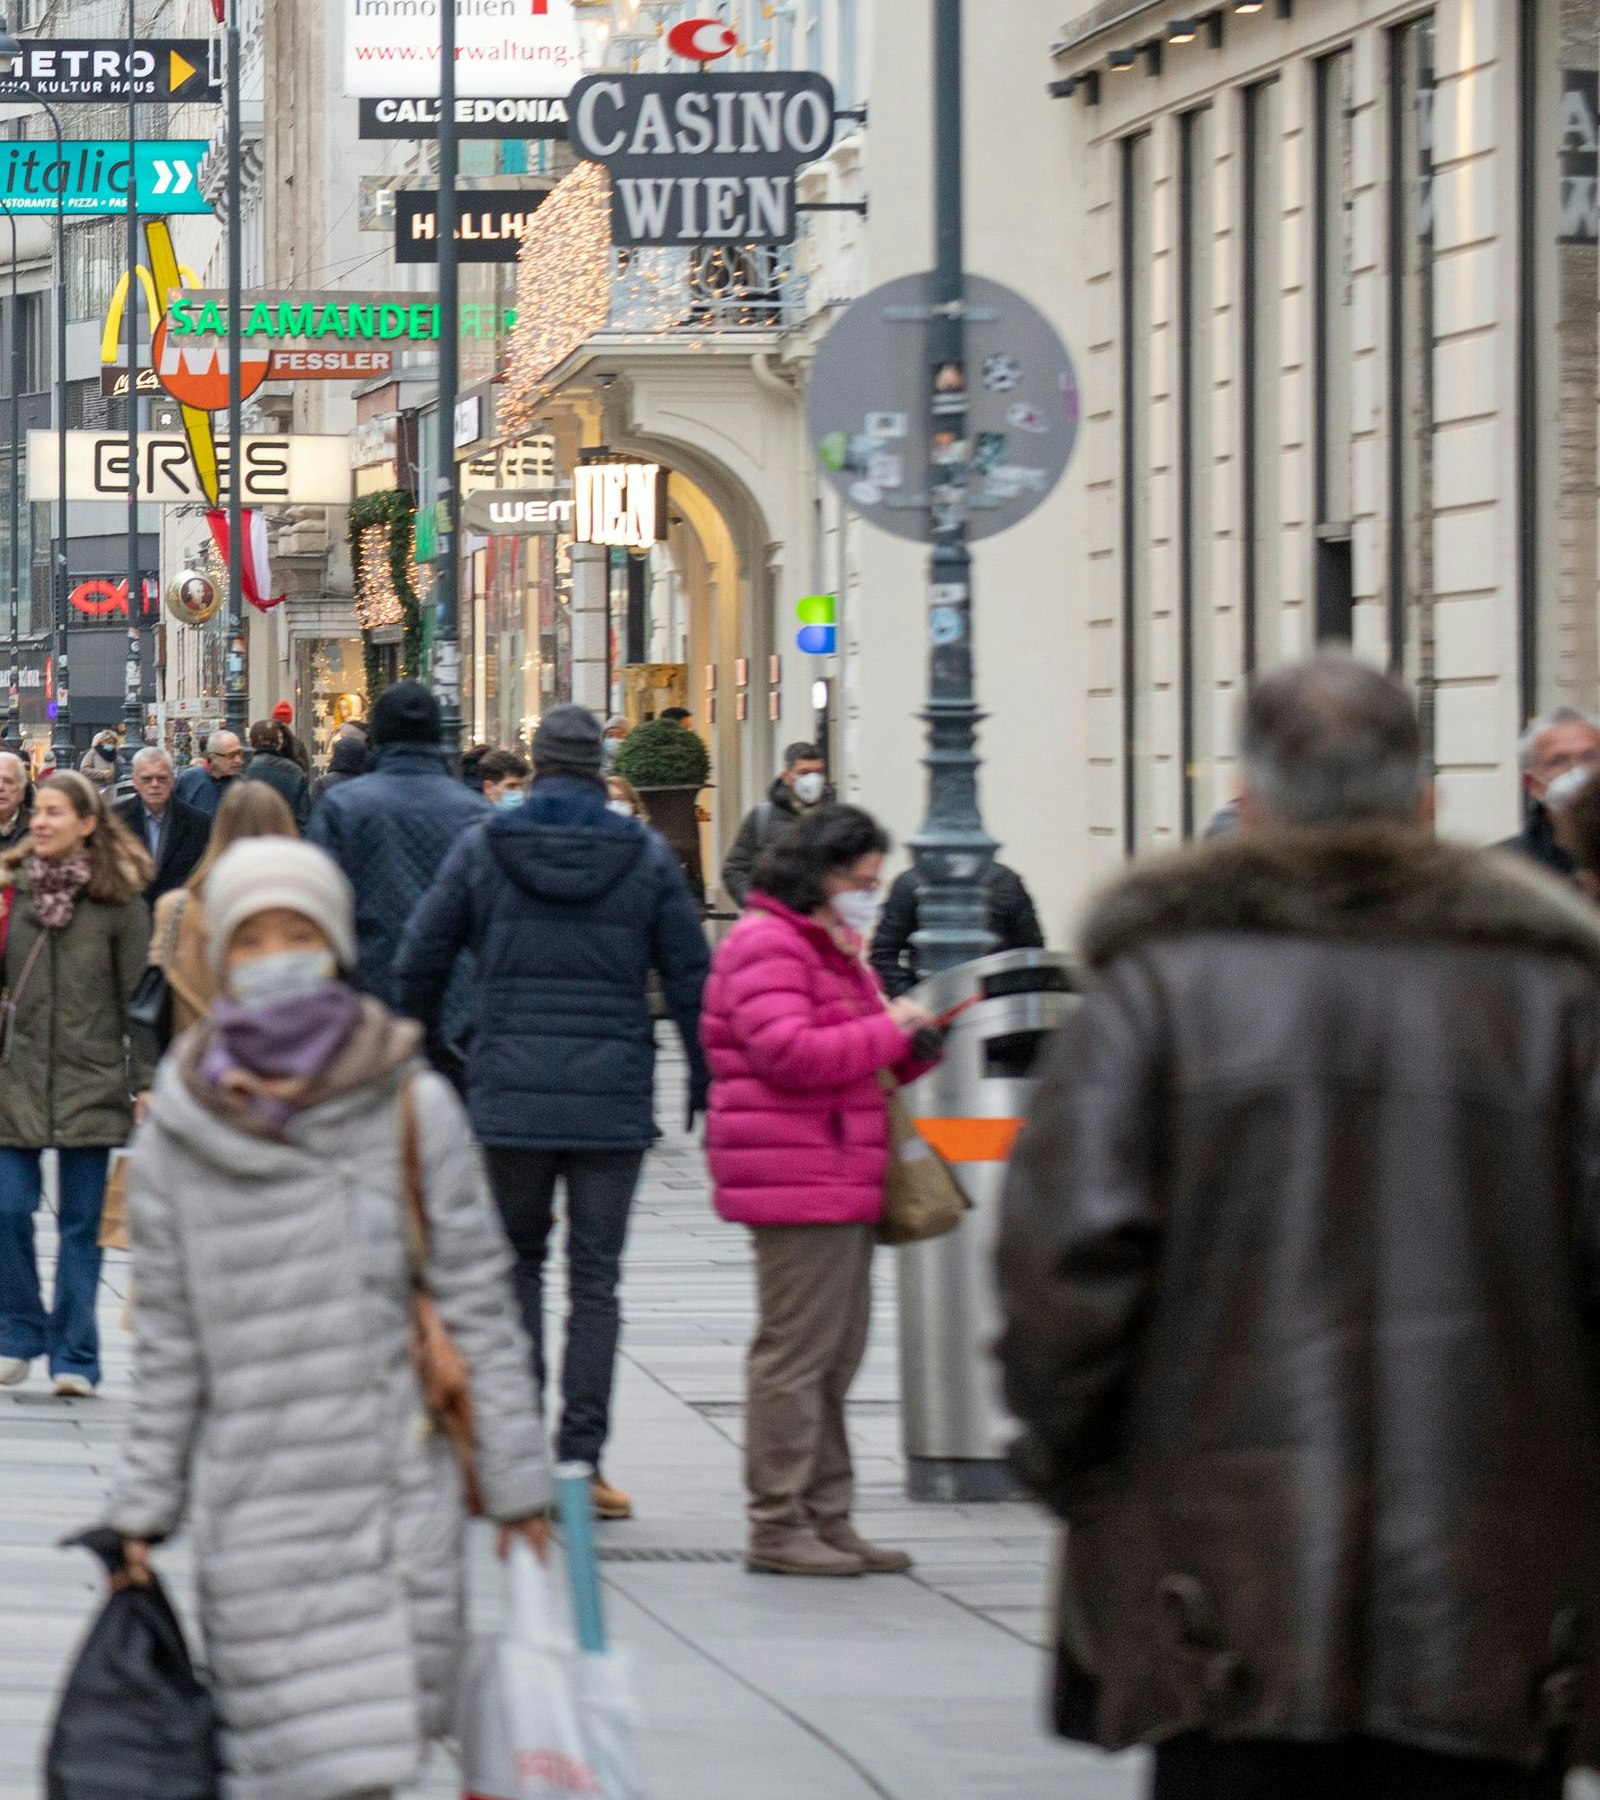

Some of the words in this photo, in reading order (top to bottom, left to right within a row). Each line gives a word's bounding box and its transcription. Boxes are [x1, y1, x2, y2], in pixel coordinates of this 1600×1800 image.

[355, 0, 516, 17] Immoilien
[355, 40, 584, 67] www.vrwaltung.
[37, 80, 103, 94] KULTUR
[110, 80, 156, 94] HAUS
[576, 82, 830, 157] CASINO
[68, 198, 98, 208] PIZZA
[108, 198, 138, 208] PAS
[615, 176, 792, 239] WIEN
[170, 297, 442, 339] SAAMANDE
[274, 352, 390, 370] FESSLER
